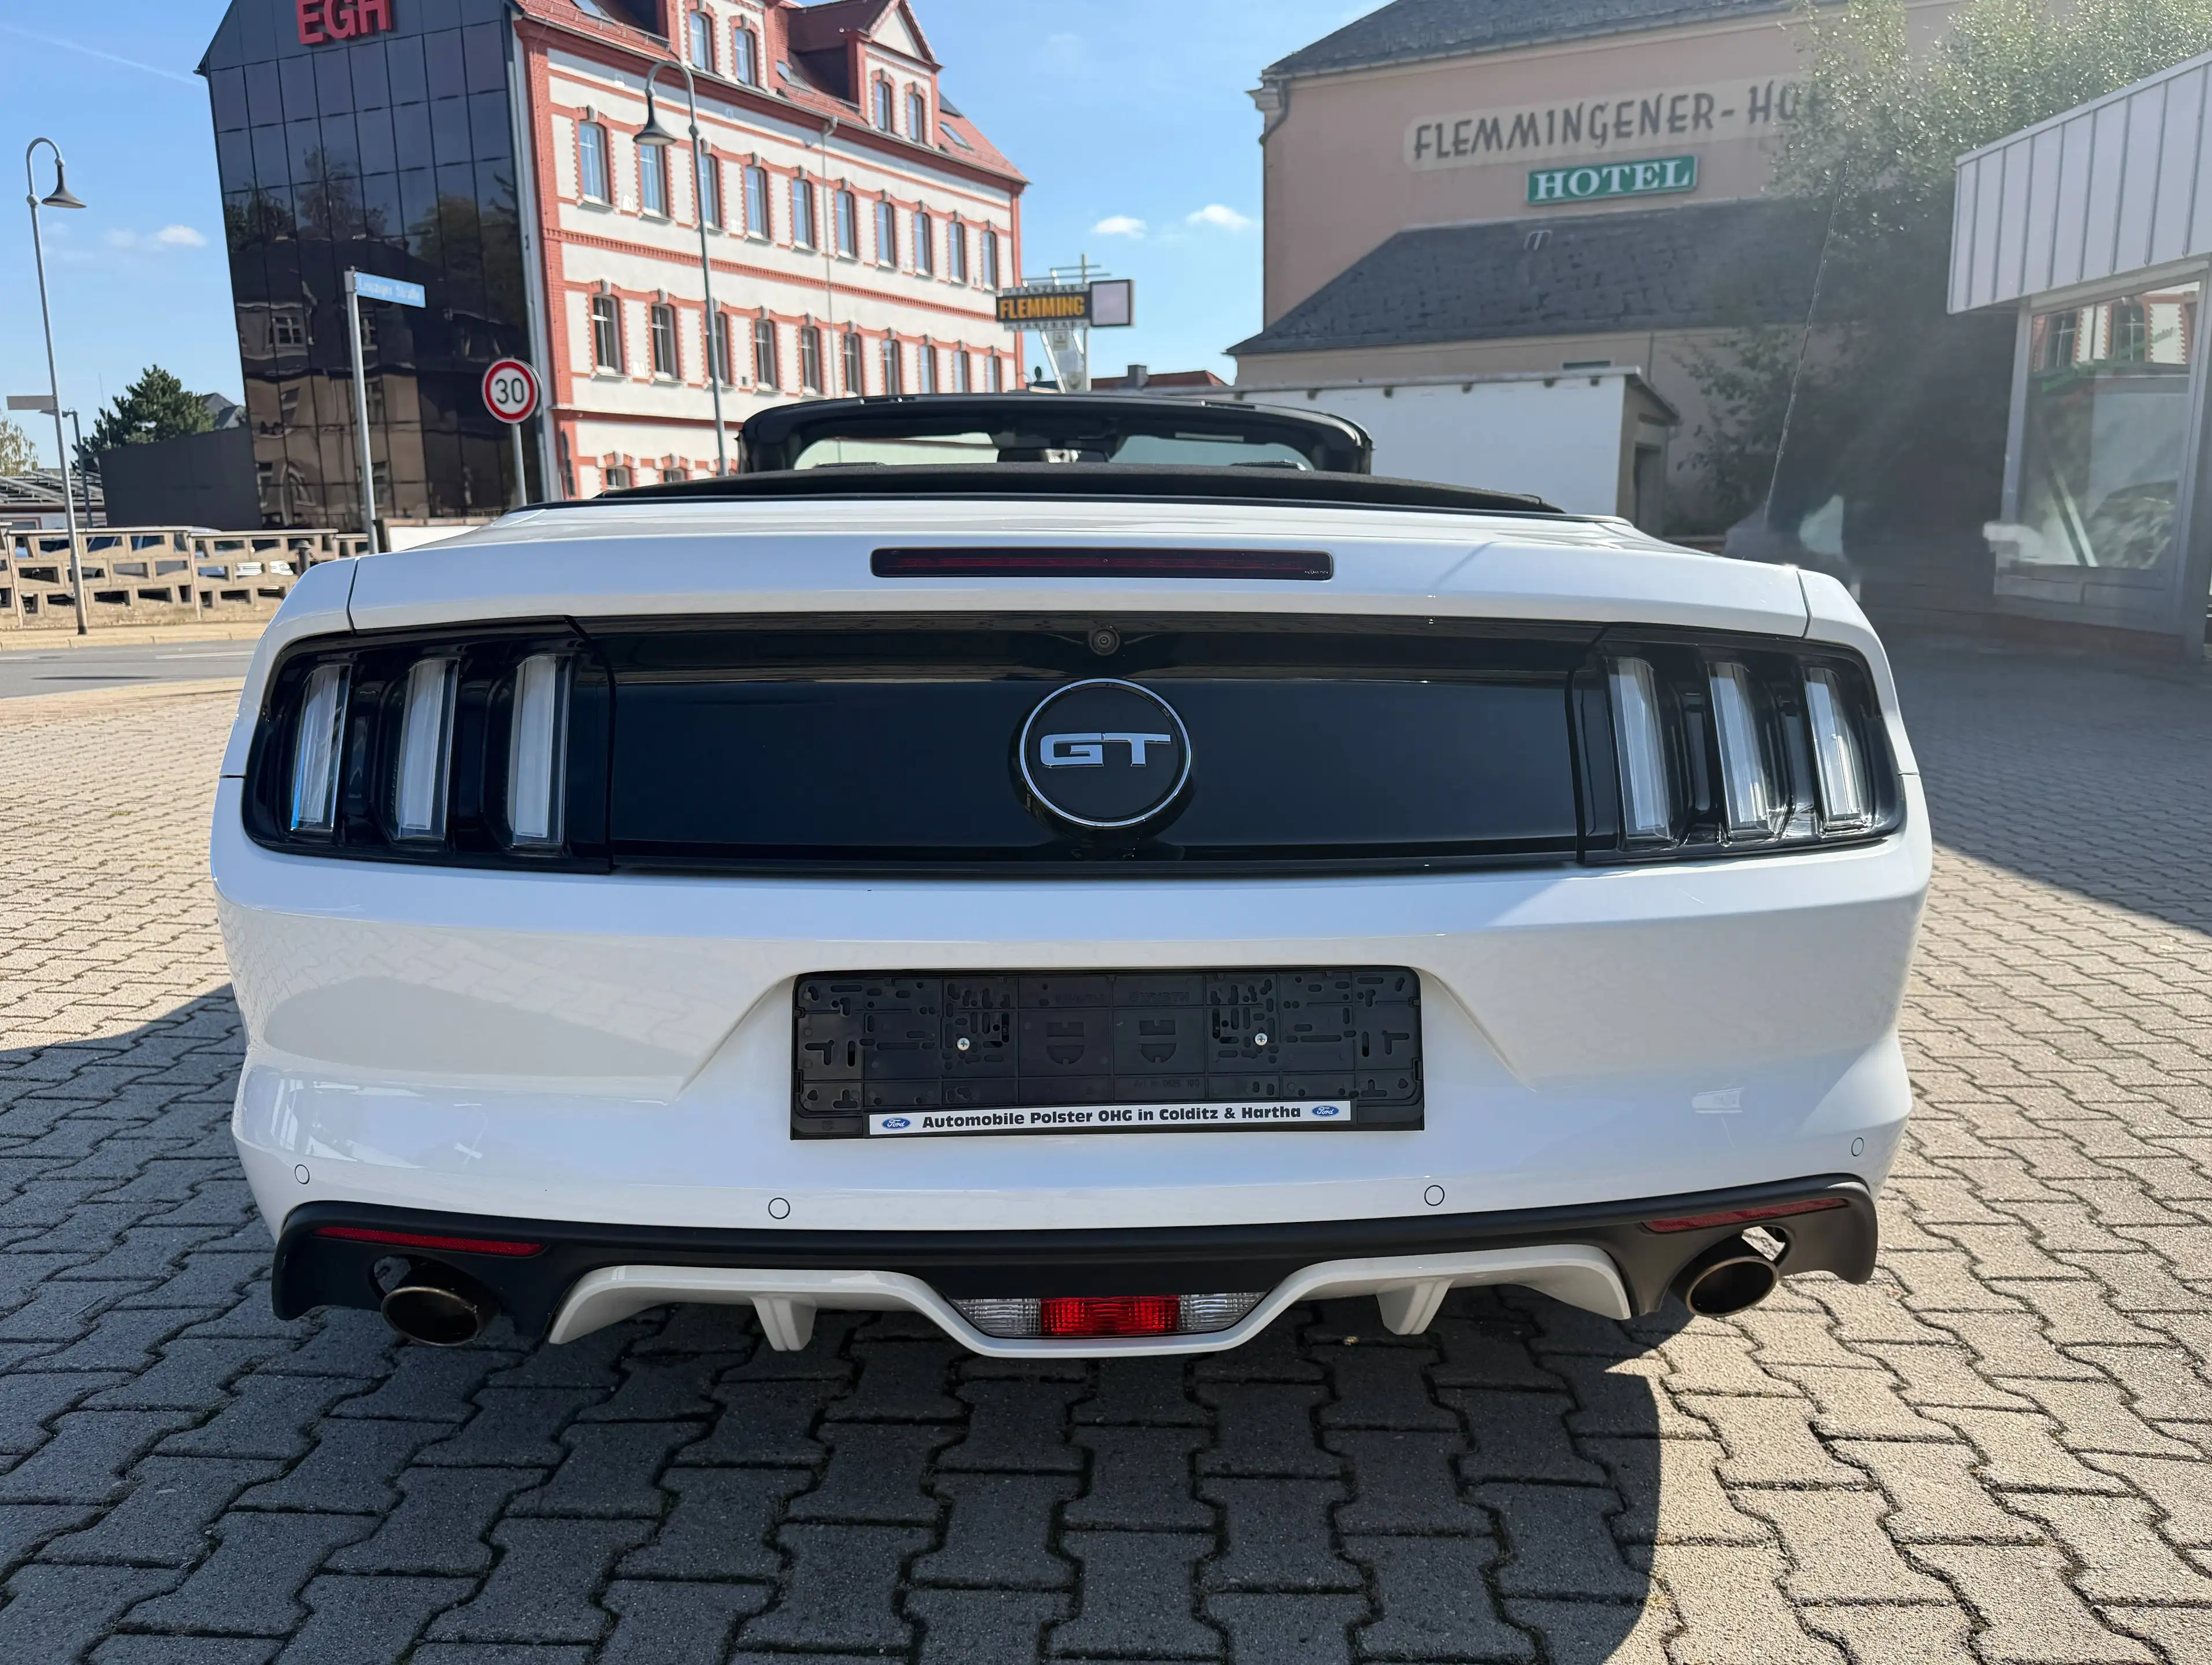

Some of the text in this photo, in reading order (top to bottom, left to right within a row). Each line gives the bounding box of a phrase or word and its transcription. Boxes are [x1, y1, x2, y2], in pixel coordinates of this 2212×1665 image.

[297, 0, 392, 45] EGH
[1414, 80, 1799, 161] FLEMMINGENER-HO
[1535, 158, 1691, 200] HOTEL
[1000, 295, 1085, 320] FLEMMING
[495, 378, 525, 405] 30
[1040, 732, 1172, 768] GT
[922, 1105, 1301, 1128] Automobile Polster OHG in Colditz & Hartha
